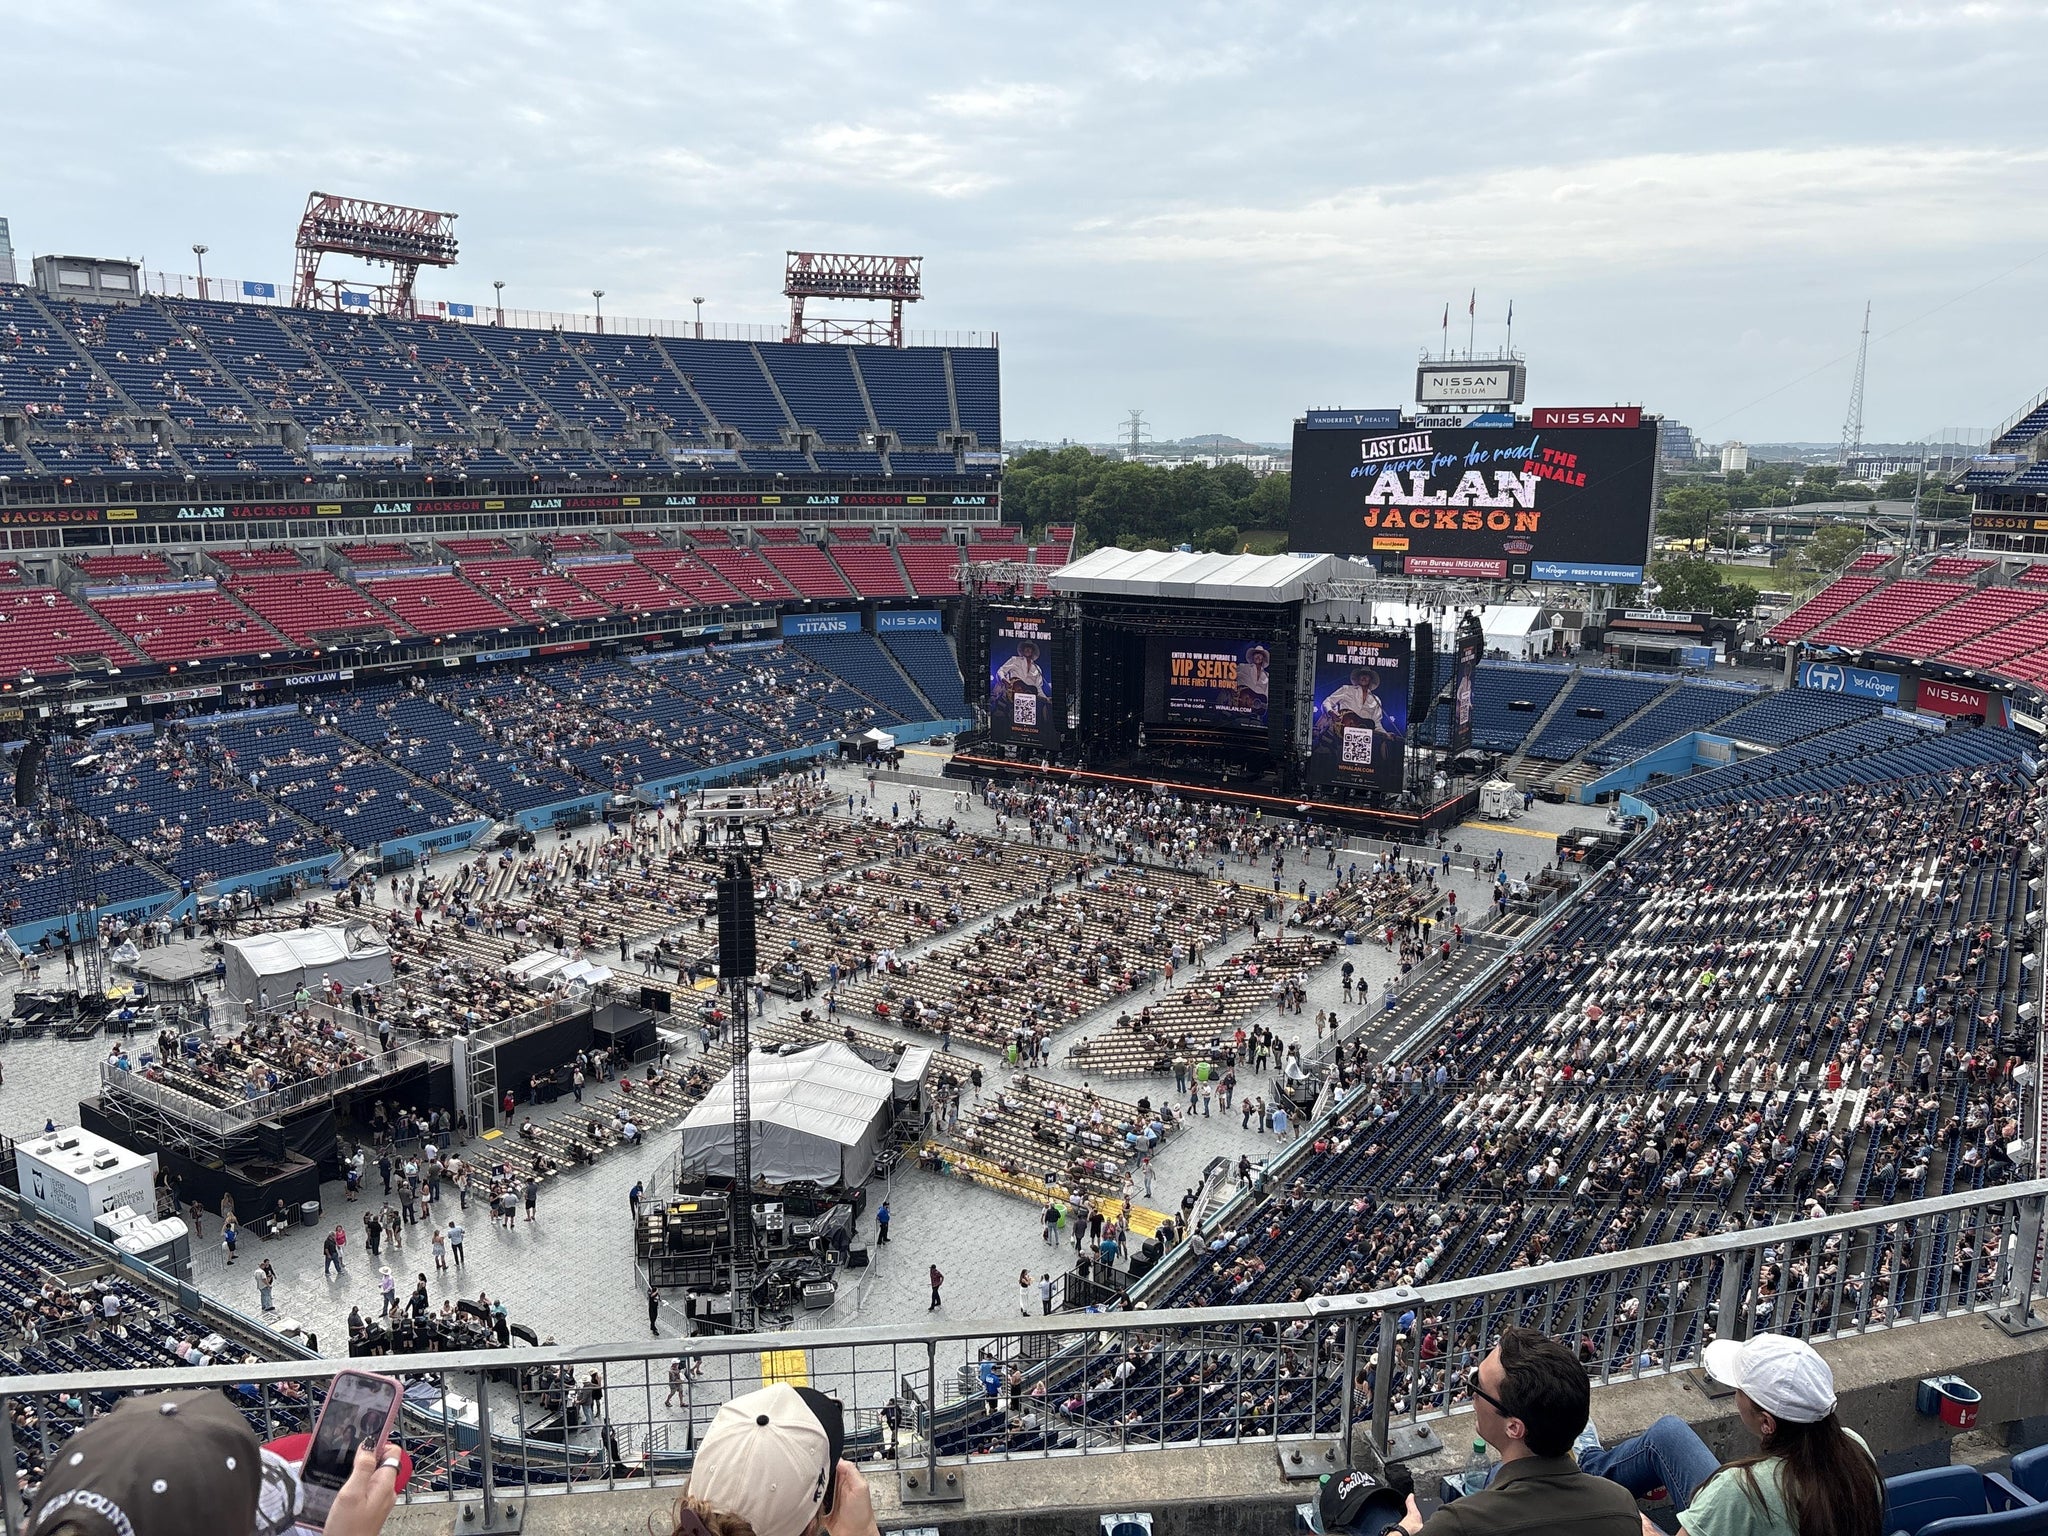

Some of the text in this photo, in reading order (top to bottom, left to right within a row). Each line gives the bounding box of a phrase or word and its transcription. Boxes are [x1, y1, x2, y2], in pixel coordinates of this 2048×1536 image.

[1433, 377, 1497, 386] NISSAN
[1416, 416, 1462, 427] Pinnacle
[1546, 414, 1625, 424] NISSAN
[1362, 436, 1433, 459] LAST CALL
[1350, 463, 1378, 478] one
[1382, 458, 1425, 475] more
[1431, 453, 1458, 476] for
[1464, 441, 1490, 467] the
[1543, 448, 1578, 468] THE
[1523, 461, 1587, 487] FINALE
[1364, 470, 1541, 508] ALAN
[530, 499, 562, 509] ALAN
[566, 498, 619, 508] JACKSON
[665, 496, 696, 505] ALAN
[700, 495, 757, 504] JACKSON
[806, 496, 839, 504] ALAN
[843, 495, 902, 504] JACKSON
[952, 496, 986, 505] ALAN
[177, 506, 225, 518] ALAN
[232, 505, 311, 517] JACKSON
[373, 502, 412, 513] ALAN
[416, 500, 480, 512] JACKSON
[1, 509, 99, 524] JACKSON
[1364, 508, 1541, 532] JACKSON
[1973, 516, 2028, 528] CKSON
[1456, 560, 1500, 568] INSURANCE
[1546, 565, 1568, 578] Kroger
[798, 621, 846, 632] TITANS
[881, 617, 937, 626] NISSAN
[1023, 623, 1038, 631] SEATS
[1347, 646, 1379, 656] VIP SEATS
[1327, 654, 1398, 668] IN THE FIRST 10 ROWS!
[1172, 659, 1237, 680] VIP SEATS
[286, 673, 337, 686] ROCKY LAW
[1171, 677, 1177, 686] IN
[1179, 677, 1190, 686] THE
[1192, 678, 1208, 687] FIRST
[1865, 676, 1894, 696] Kroger
[240, 681, 265, 692] FedEx
[1927, 687, 1979, 706] NISSAN
[52, 1179, 65, 1189] EVENT
[113, 1190, 131, 1198] EVENT
[114, 1190, 144, 1204] RESTROOM
[54, 1194, 78, 1213] TRAILERS
[115, 1196, 144, 1210] TRAILERS
